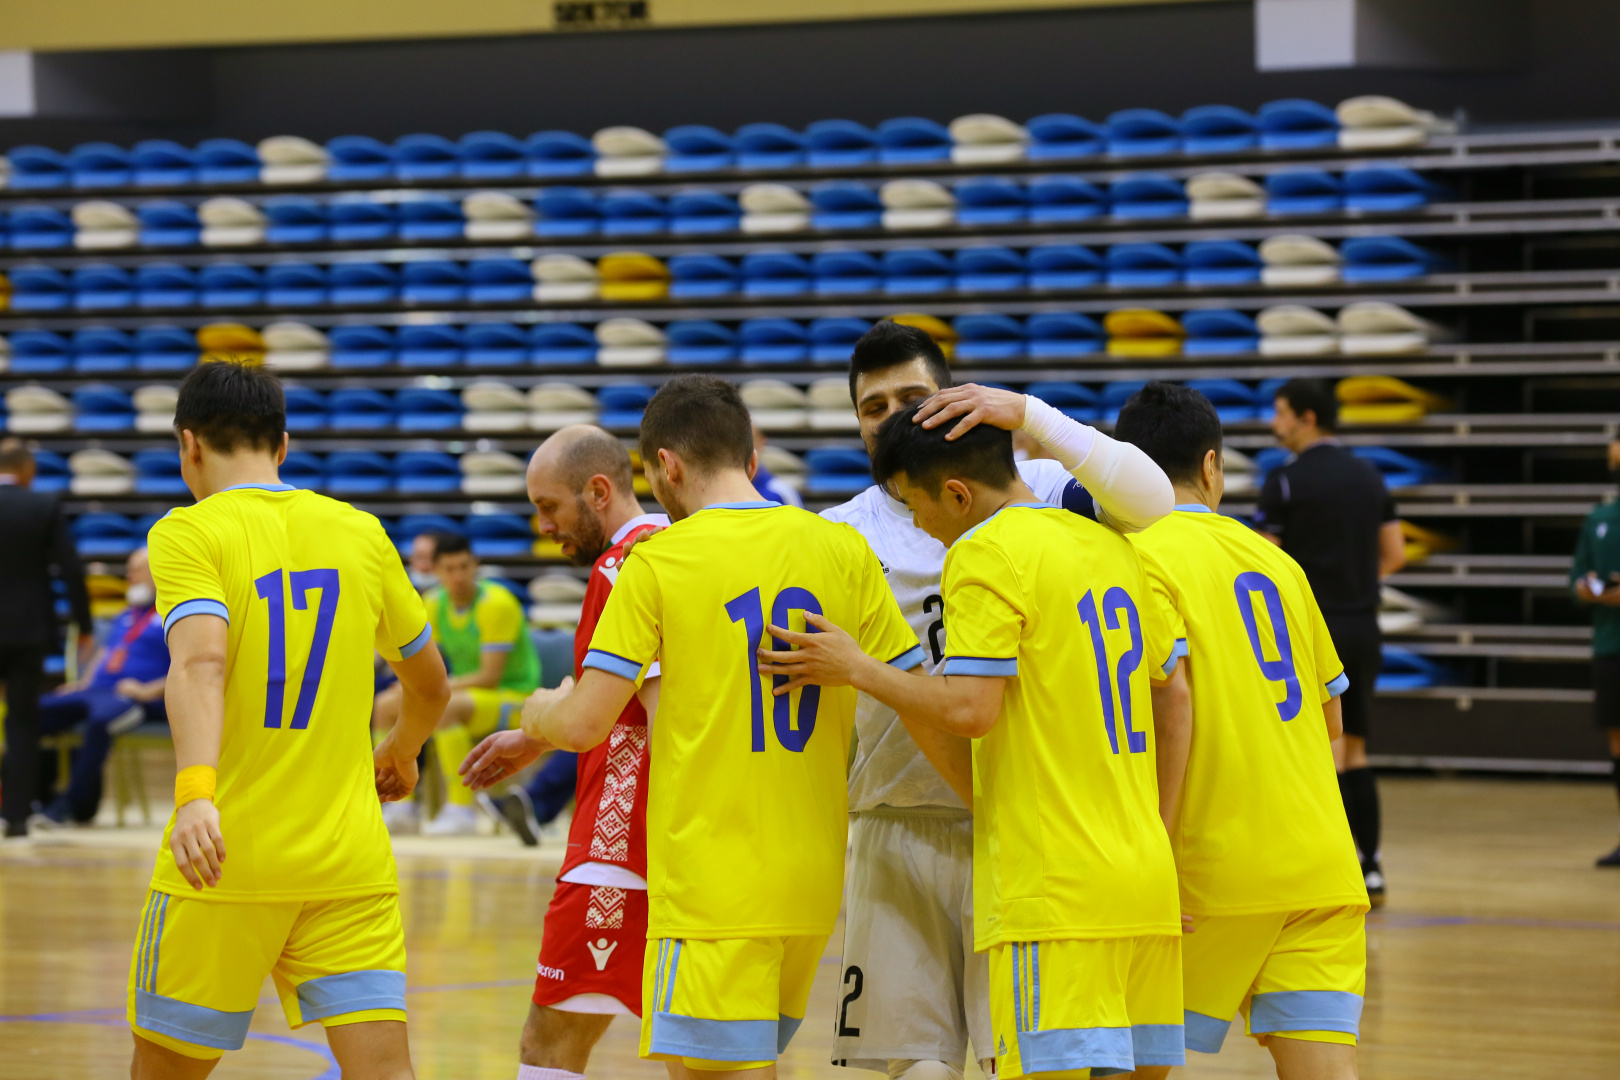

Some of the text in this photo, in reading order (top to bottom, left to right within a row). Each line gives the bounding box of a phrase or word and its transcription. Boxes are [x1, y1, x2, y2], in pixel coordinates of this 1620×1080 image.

[254, 568, 340, 729] 17
[724, 586, 823, 752] 10
[1077, 586, 1146, 755] 12
[1234, 571, 1302, 722] 9
[839, 965, 863, 1037] 2
